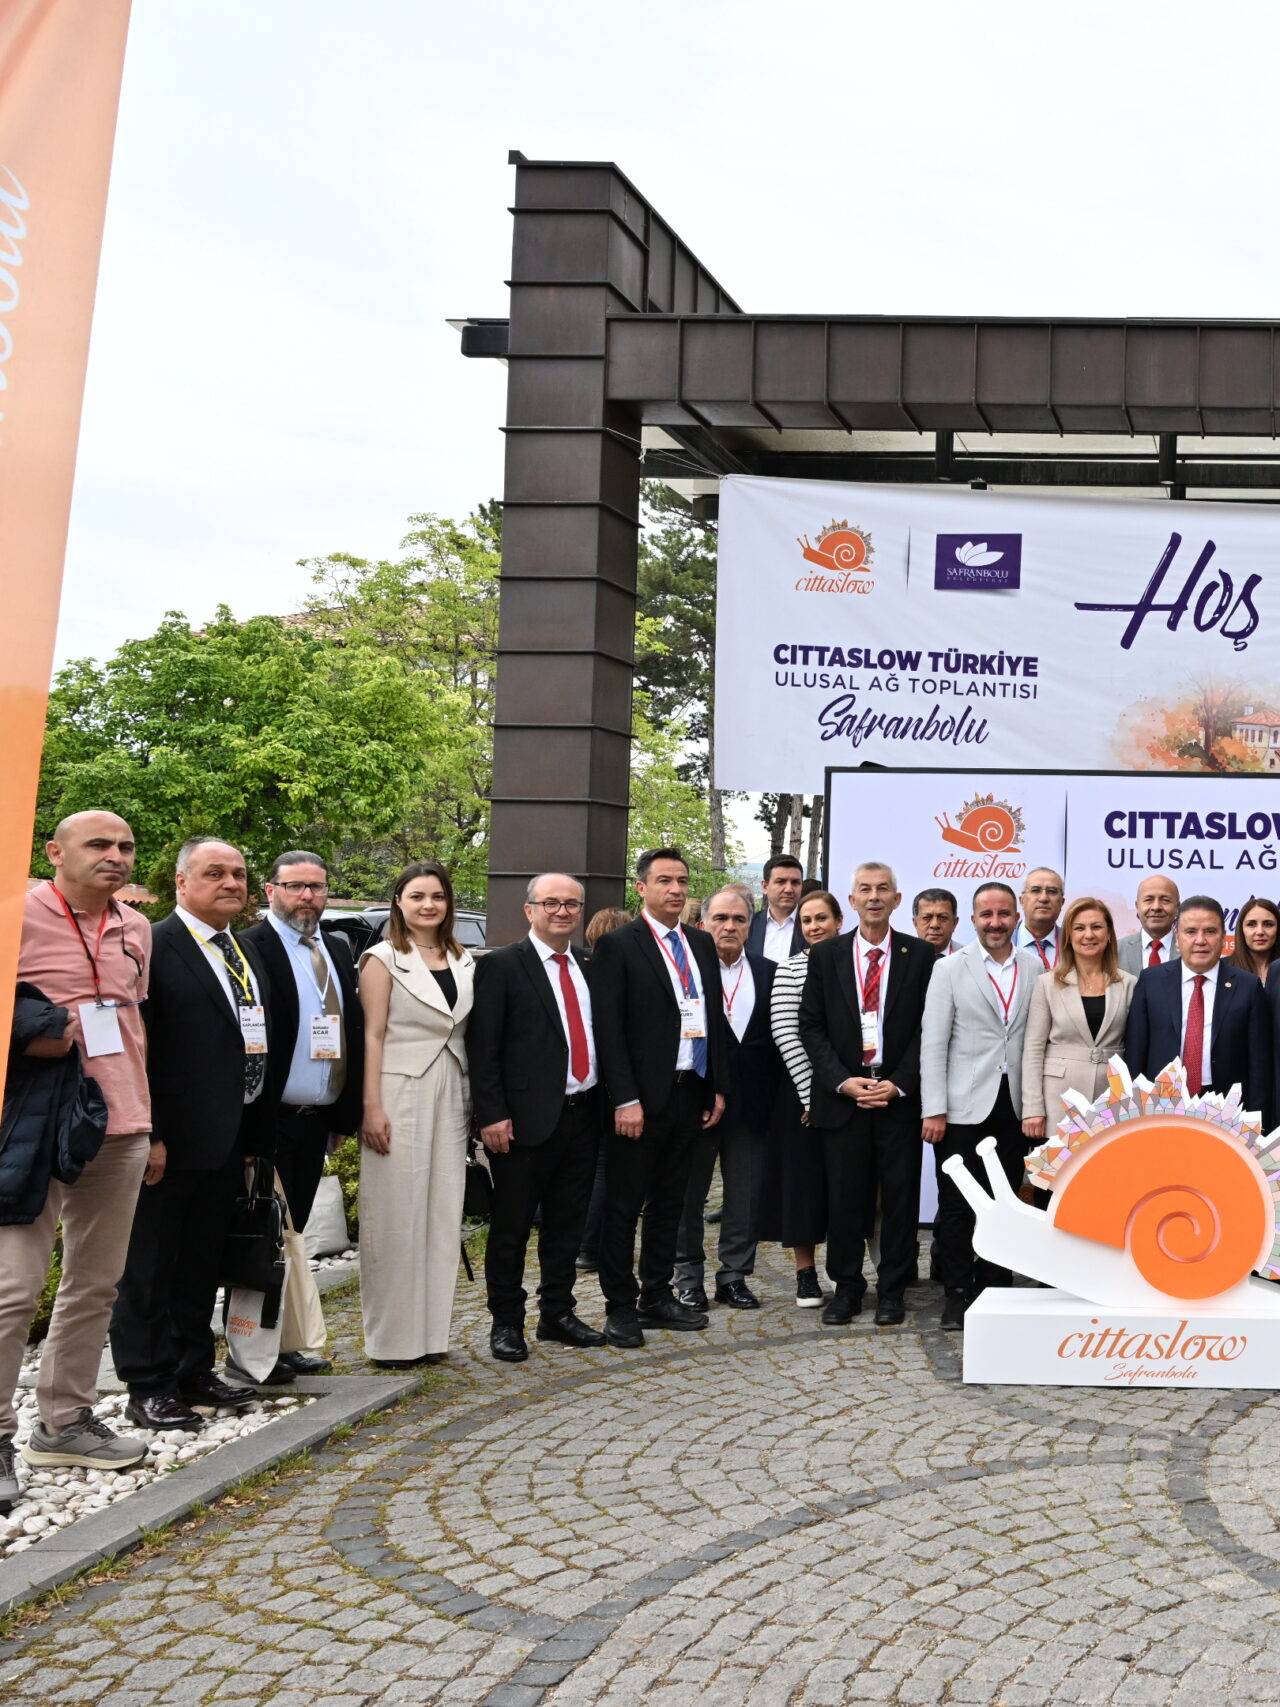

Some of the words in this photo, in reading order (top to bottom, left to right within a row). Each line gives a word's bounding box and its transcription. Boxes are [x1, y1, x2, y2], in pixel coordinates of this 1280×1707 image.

[794, 570, 875, 594] cittaslow
[946, 568, 1009, 578] SAFRANBOLU
[1074, 531, 1262, 651] Hoş
[773, 643, 922, 673] CITTASLOW
[928, 647, 1039, 678] TÜRKİYE
[775, 671, 860, 690] ULUSAL
[868, 673, 900, 692] AĞ
[908, 678, 1038, 699] TOPLANTISI
[818, 694, 989, 747] Safranbolu
[933, 853, 1028, 879] cittaslow
[1107, 848, 1224, 870] ULUSAL
[1235, 844, 1278, 871] AĞ
[1057, 1319, 1248, 1361] cittaslow
[1104, 1363, 1198, 1385] Safranbolu
